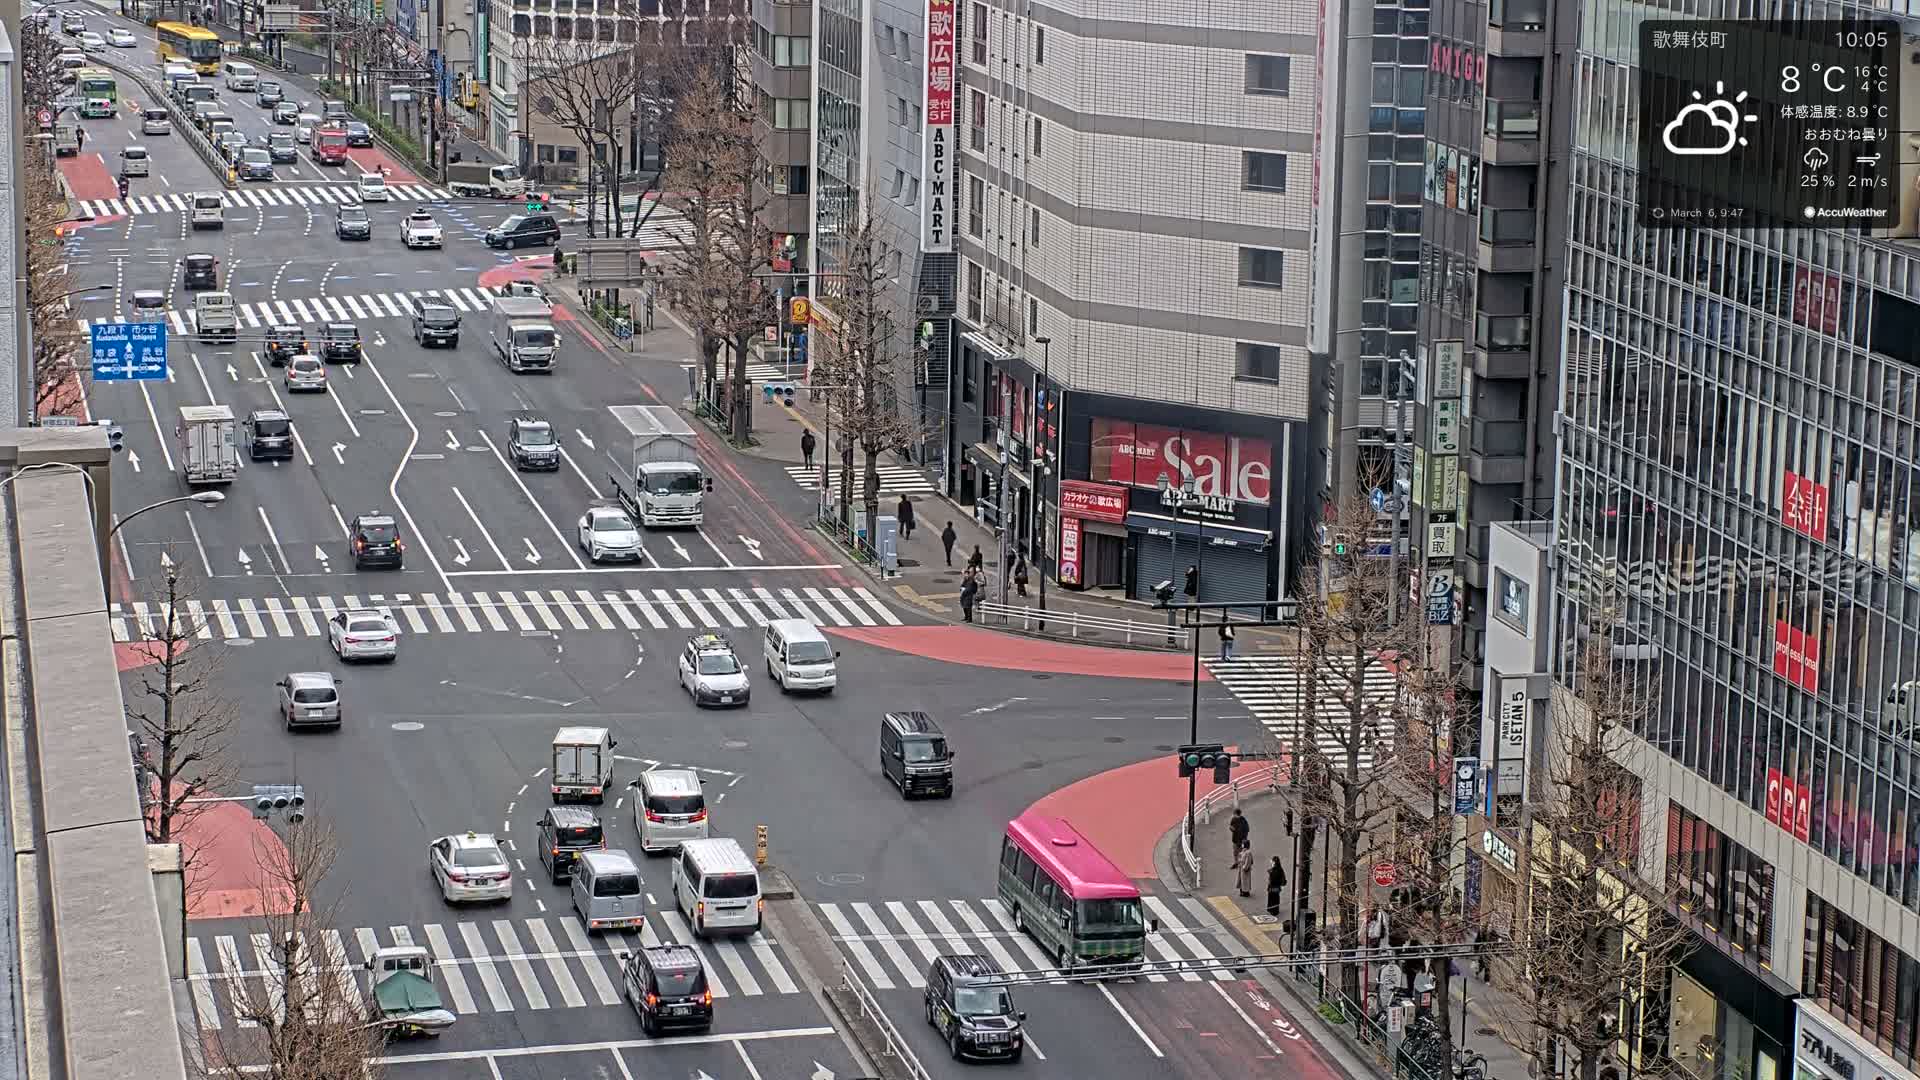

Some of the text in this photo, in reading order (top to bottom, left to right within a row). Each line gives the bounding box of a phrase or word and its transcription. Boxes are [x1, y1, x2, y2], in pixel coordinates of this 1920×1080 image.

[930, 10, 952, 92] 歌広場
[1431, 42, 1484, 84] AMIGO
[929, 99, 951, 110] 受付
[1118, 443, 1156, 457] ABCMART
[1163, 436, 1270, 501] Sale
[1063, 491, 1122, 509] カラオケの歌広場
[1787, 481, 1823, 530] 会計
[1432, 526, 1445, 554] 買取
[1510, 691, 1524, 746] ISETAN 5
[1768, 779, 1808, 827] CPA
